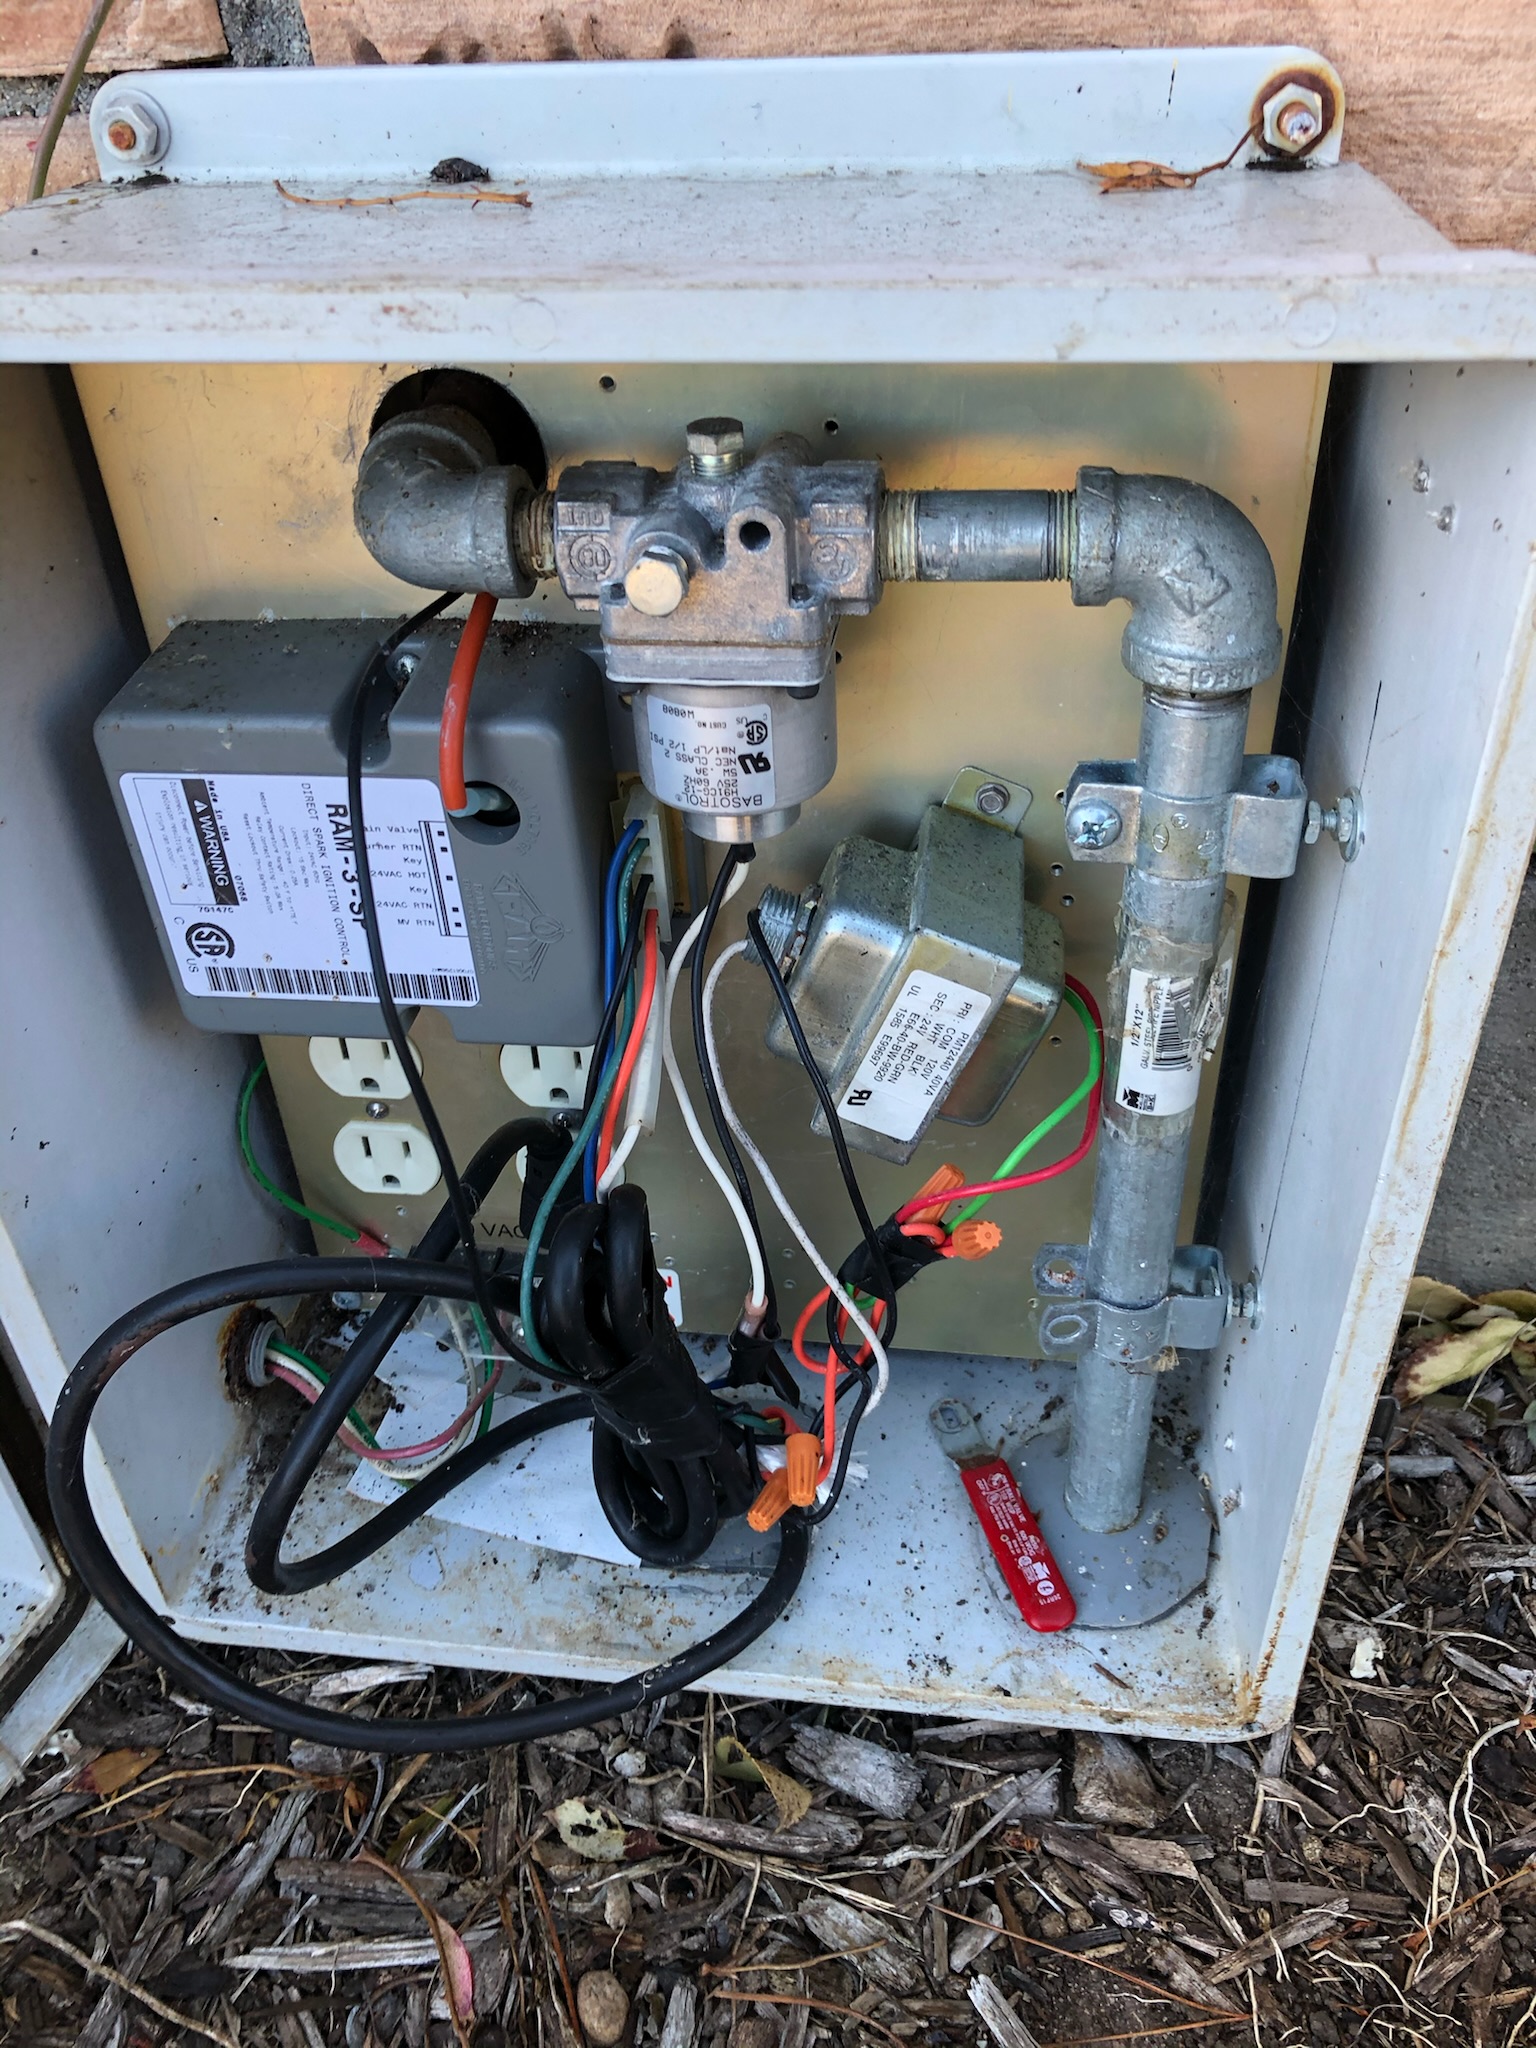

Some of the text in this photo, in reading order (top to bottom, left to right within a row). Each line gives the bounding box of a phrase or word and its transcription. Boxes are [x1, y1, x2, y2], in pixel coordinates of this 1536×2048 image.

[669, 740, 685, 751] 1/2
[665, 750, 737, 766] NEC CLASS 2
[684, 775, 738, 787] 25V 60HZ
[208, 780, 230, 842] Made in USA
[199, 816, 229, 886] WARNING
[366, 842, 396, 850] urner
[301, 783, 350, 957] DIRECT SPARK IGNITION CONTROL
[404, 857, 422, 865] Key
[410, 886, 428, 894] Key
[186, 958, 199, 973] US
[869, 985, 921, 1066] UL 1585 E99697
[916, 1017, 931, 1036] 24V
[874, 1012, 920, 1082] E66-40-BW-9920
[908, 1023, 945, 1074] WHT BLK
[937, 1027, 956, 1050] COM
[887, 1041, 918, 1083] RED-GRN
[920, 1059, 938, 1080] 120V
[924, 1032, 969, 1096] PM12440 40VA
